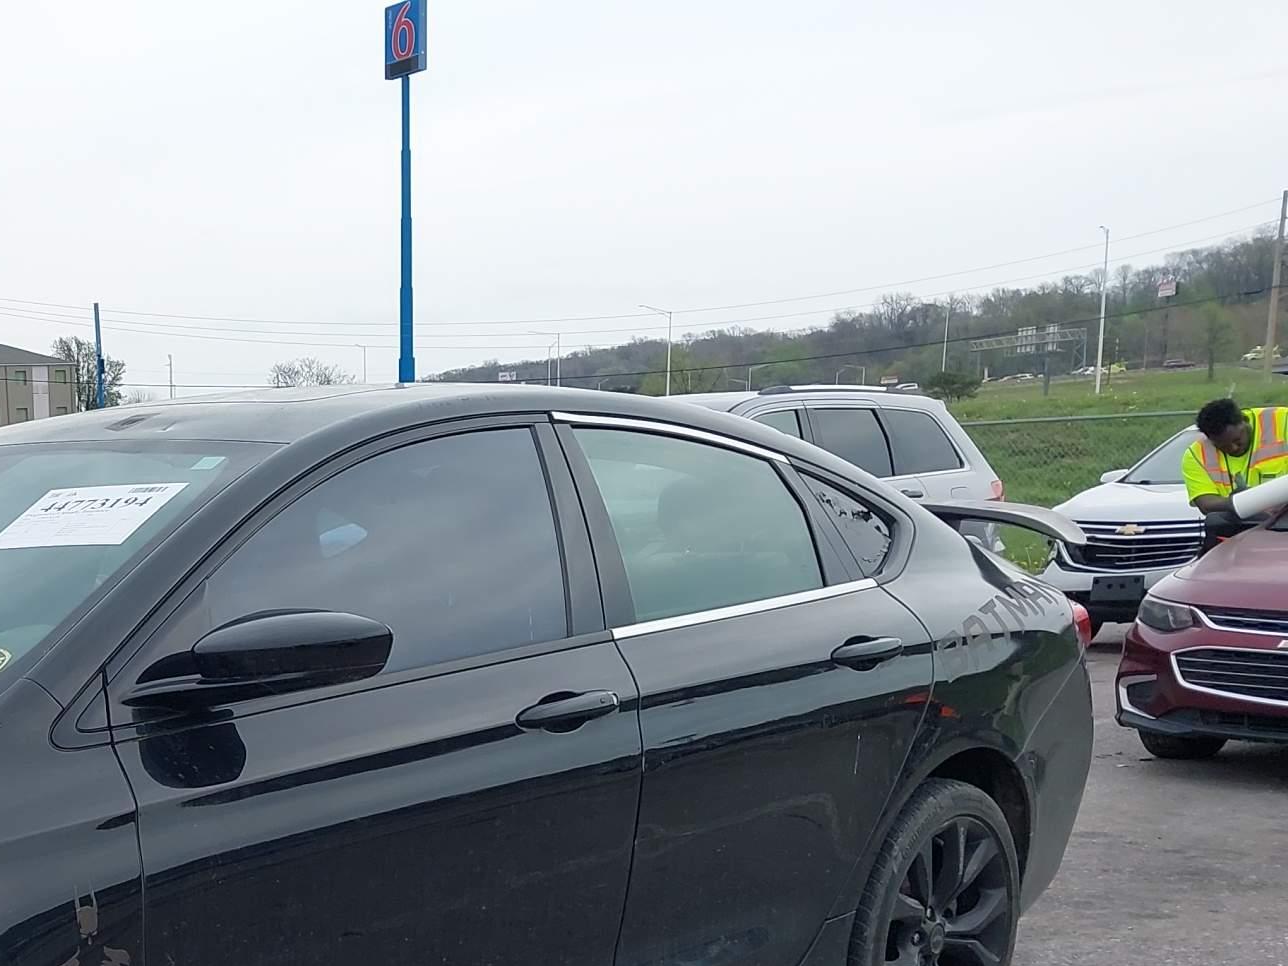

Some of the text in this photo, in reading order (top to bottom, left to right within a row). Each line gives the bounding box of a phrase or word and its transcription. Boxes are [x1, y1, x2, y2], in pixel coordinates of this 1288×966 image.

[392, 1, 415, 60] 6
[40, 496, 153, 512] 44773194
[937, 578, 1062, 682] BATMAN
